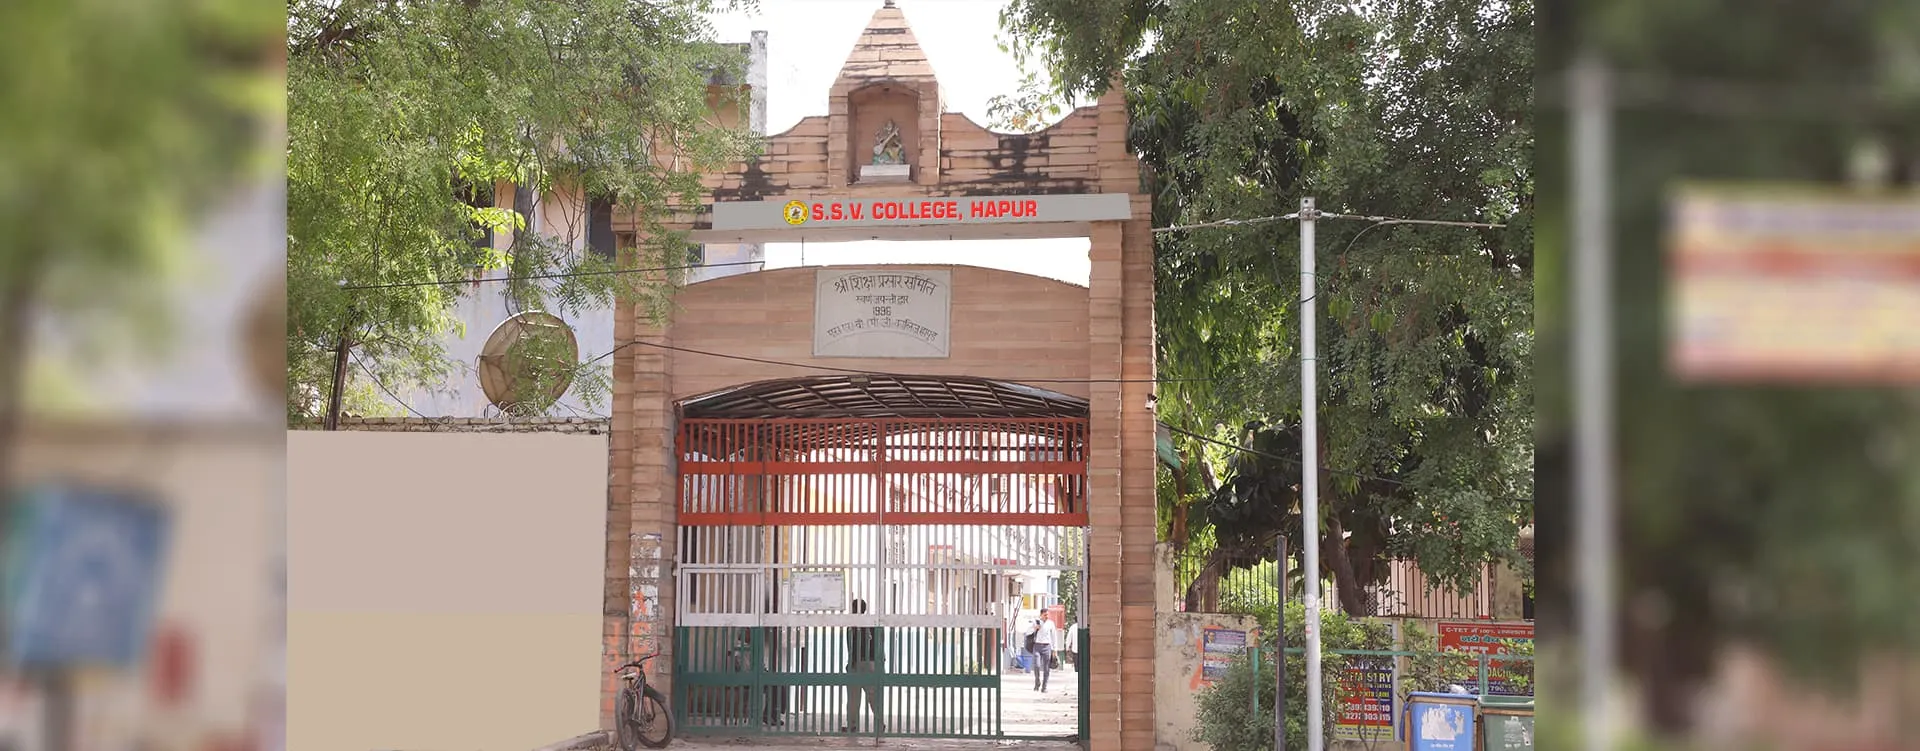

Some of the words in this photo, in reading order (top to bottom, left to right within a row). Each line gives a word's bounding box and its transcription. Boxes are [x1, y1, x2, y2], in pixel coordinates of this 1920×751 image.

[811, 203, 865, 221] S.S.V.
[872, 201, 963, 221] COLLEGE,
[970, 199, 1038, 218] HAPUR
[834, 276, 849, 294] श्री
[849, 274, 876, 291] शिक्षा
[878, 274, 903, 289] प्रसार
[872, 306, 892, 316] 1996
